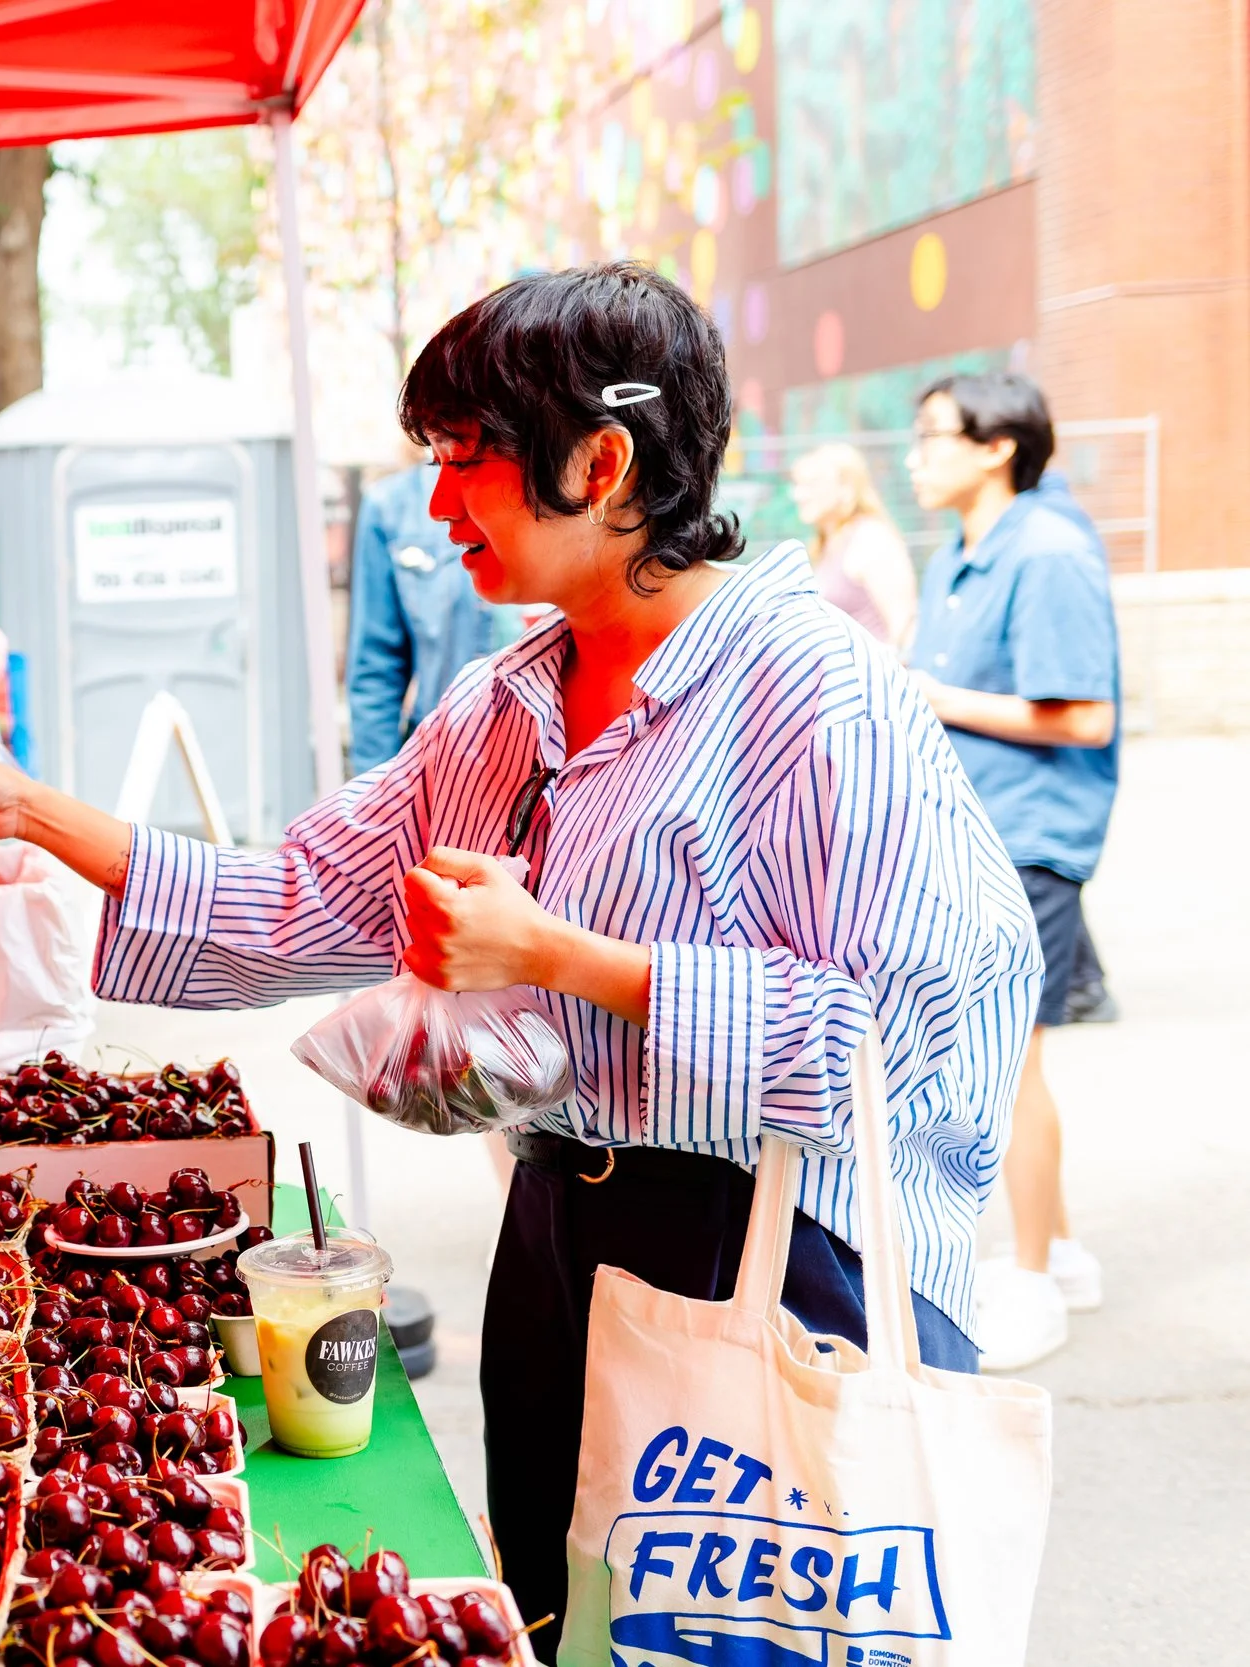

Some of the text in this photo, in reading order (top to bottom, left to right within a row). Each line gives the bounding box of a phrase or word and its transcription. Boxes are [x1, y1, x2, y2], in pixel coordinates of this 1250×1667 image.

[318, 1336, 376, 1362] FAWKES
[327, 1361, 369, 1372] COFFEE
[633, 1426, 772, 1504] GET
[629, 1531, 901, 1619] FRESH
[869, 1649, 912, 1665] EDMONTON
